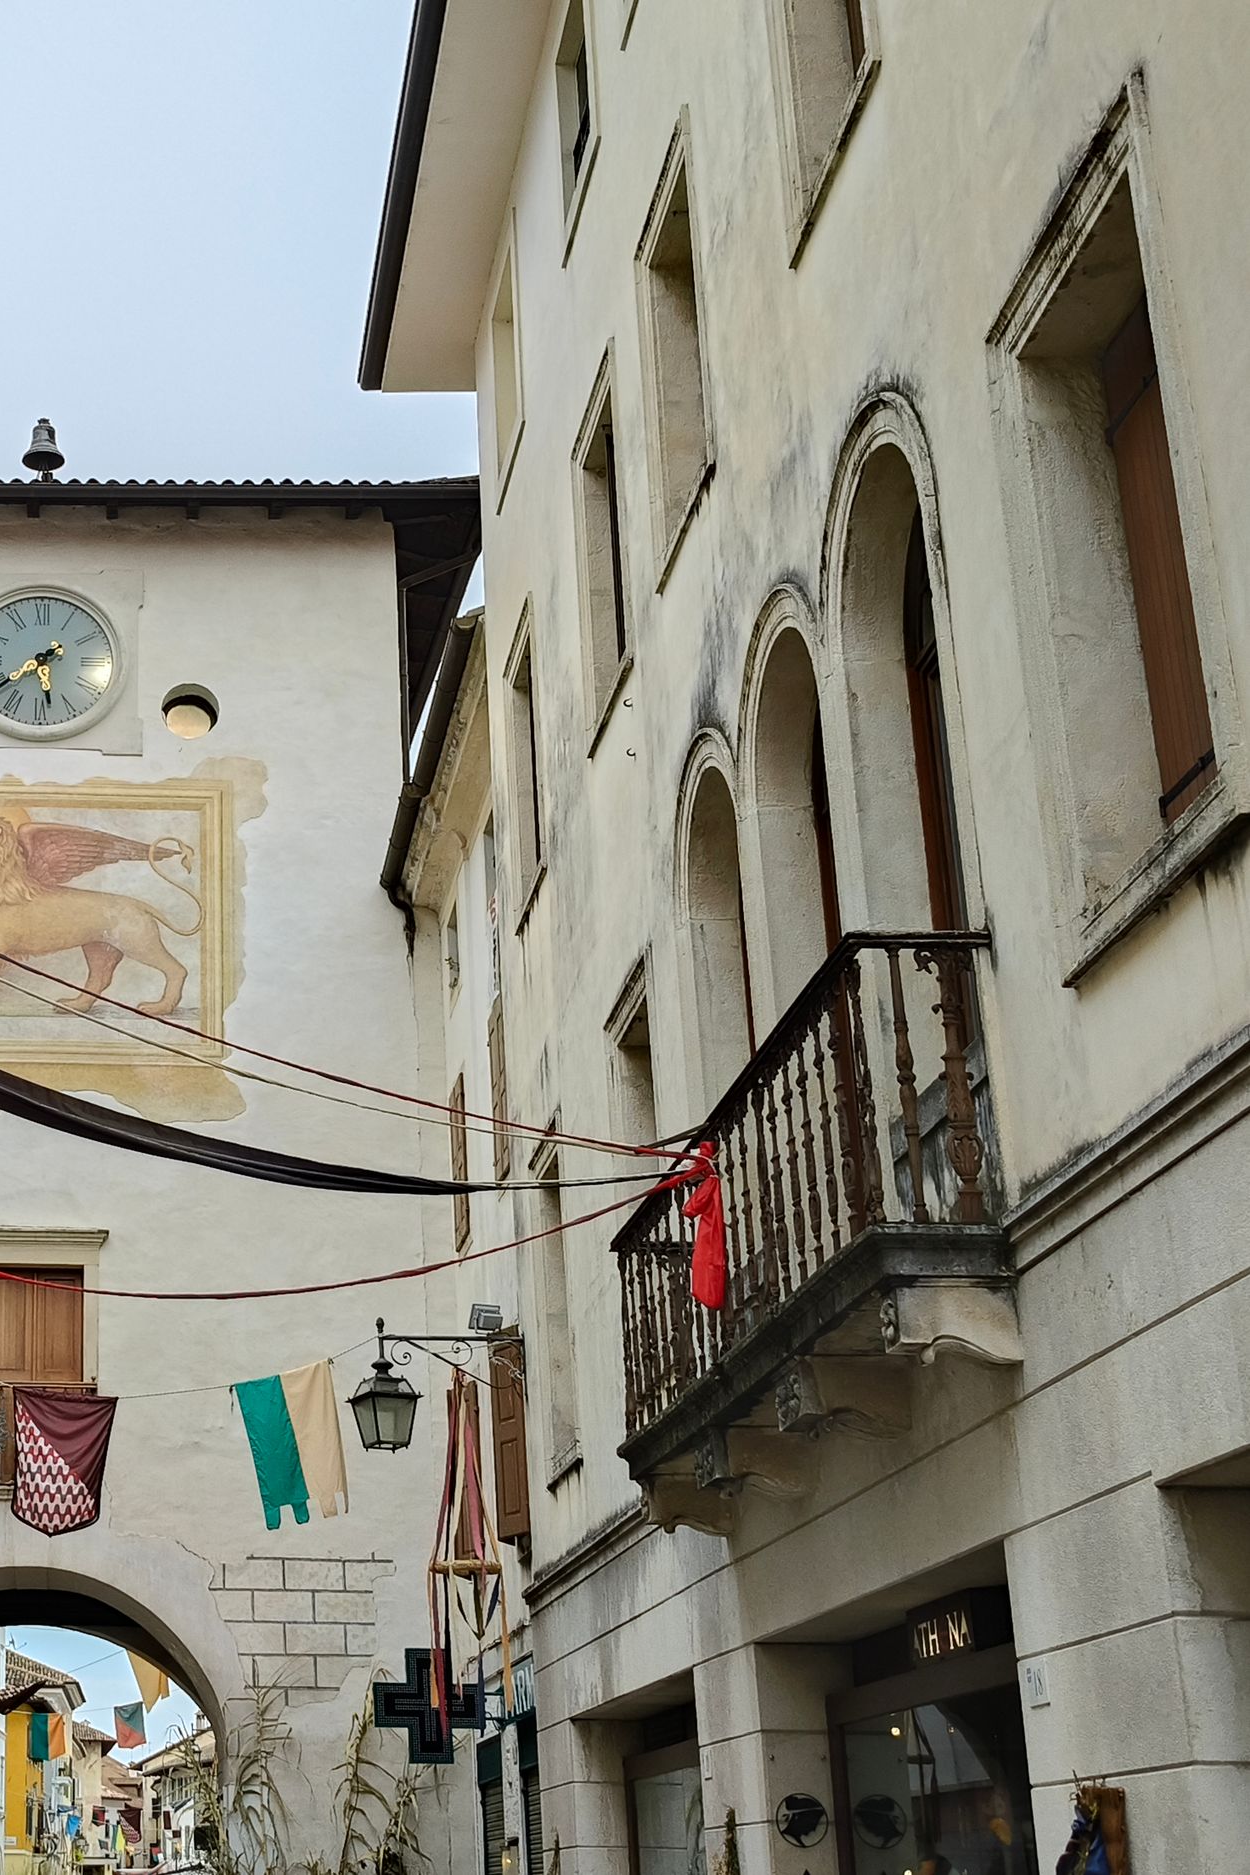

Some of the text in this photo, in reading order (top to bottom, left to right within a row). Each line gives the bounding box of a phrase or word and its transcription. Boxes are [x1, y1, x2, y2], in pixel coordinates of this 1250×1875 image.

[6, 608, 27, 632] XI
[35, 603, 50, 626] XII
[34, 697, 47, 721] VI
[61, 693, 77, 715] V
